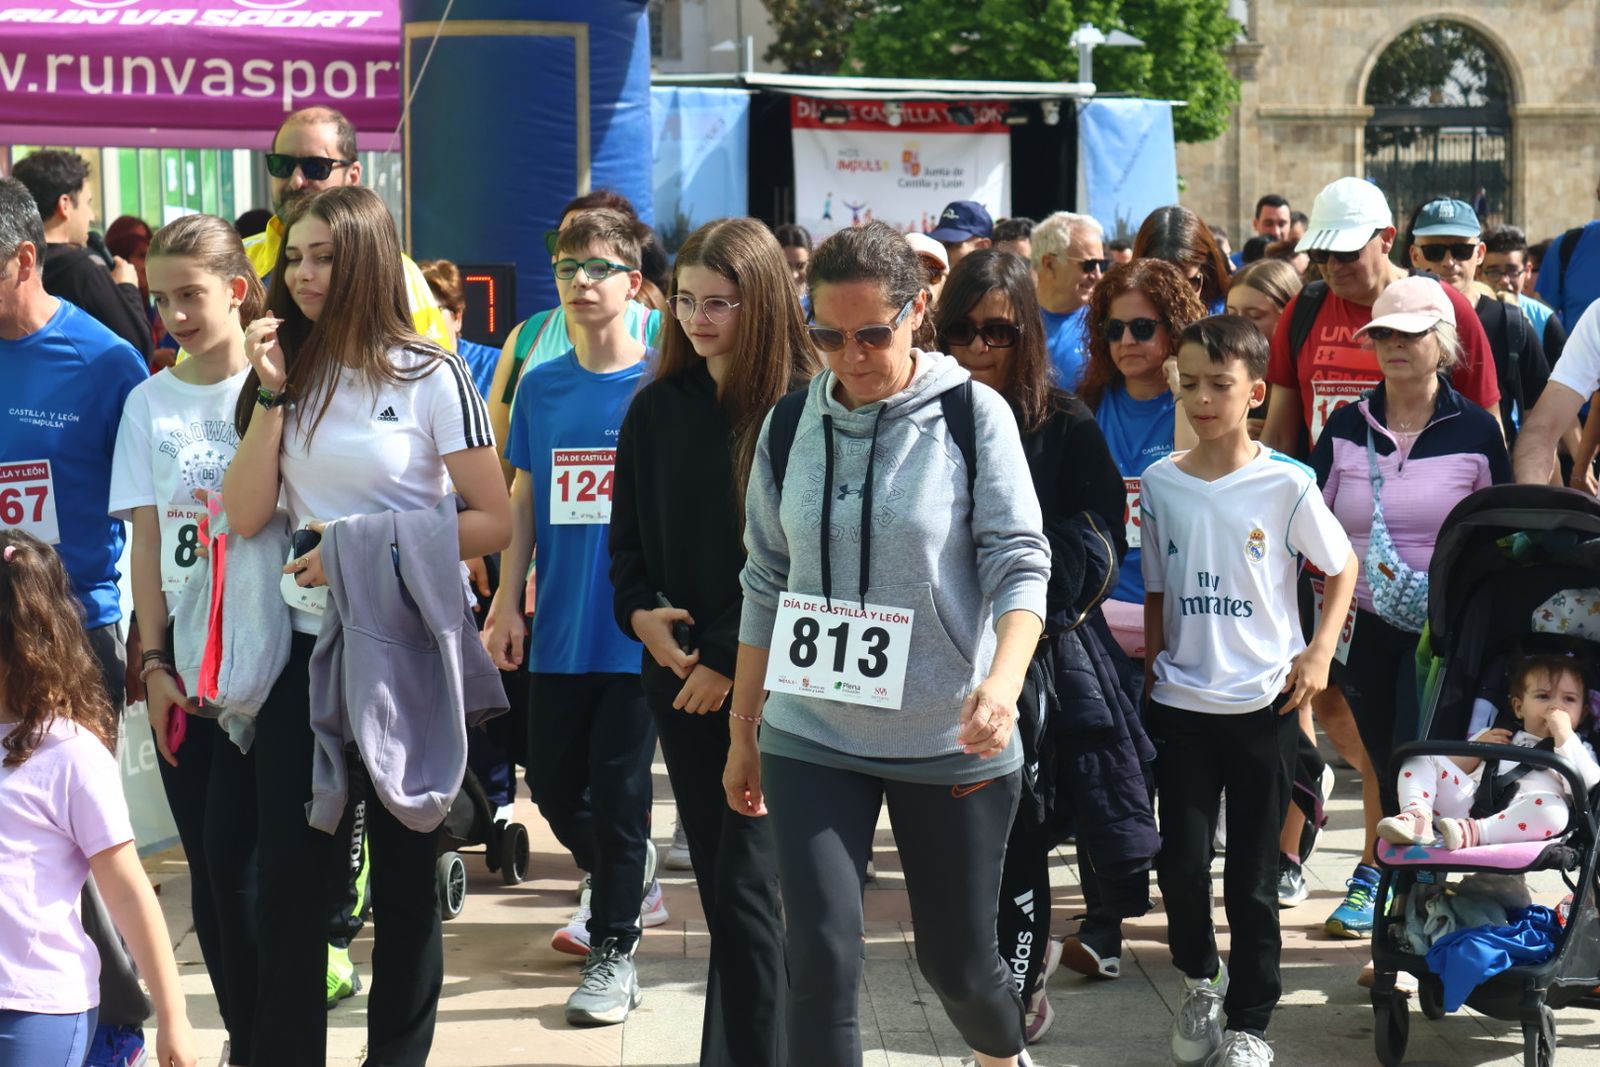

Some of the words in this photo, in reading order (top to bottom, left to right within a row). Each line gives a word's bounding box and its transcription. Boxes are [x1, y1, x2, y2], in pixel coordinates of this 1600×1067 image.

[118, 9, 190, 26] VA
[195, 9, 383, 28] SPORT
[859, 104, 941, 123] CASILLA
[464, 275, 496, 334] 7
[8, 408, 46, 418] CASTILLA
[49, 411, 56, 420] Y
[57, 412, 80, 423] LEÓN
[159, 420, 238, 459] BROWN
[556, 453, 569, 462] DÍA
[22, 466, 45, 477] LEÓN
[202, 468, 215, 480] 06
[556, 470, 615, 502] 124
[0, 485, 48, 525] 67
[167, 508, 184, 519] DÍA
[174, 523, 199, 568] 8
[1197, 571, 1220, 592] Fly
[783, 598, 801, 610] DÍA
[803, 603, 817, 612] DE
[820, 605, 867, 619] CASTILLA
[870, 611, 878, 620] Y
[879, 612, 909, 624] LEÓN
[1178, 594, 1253, 618] mrates
[789, 617, 891, 678] 813
